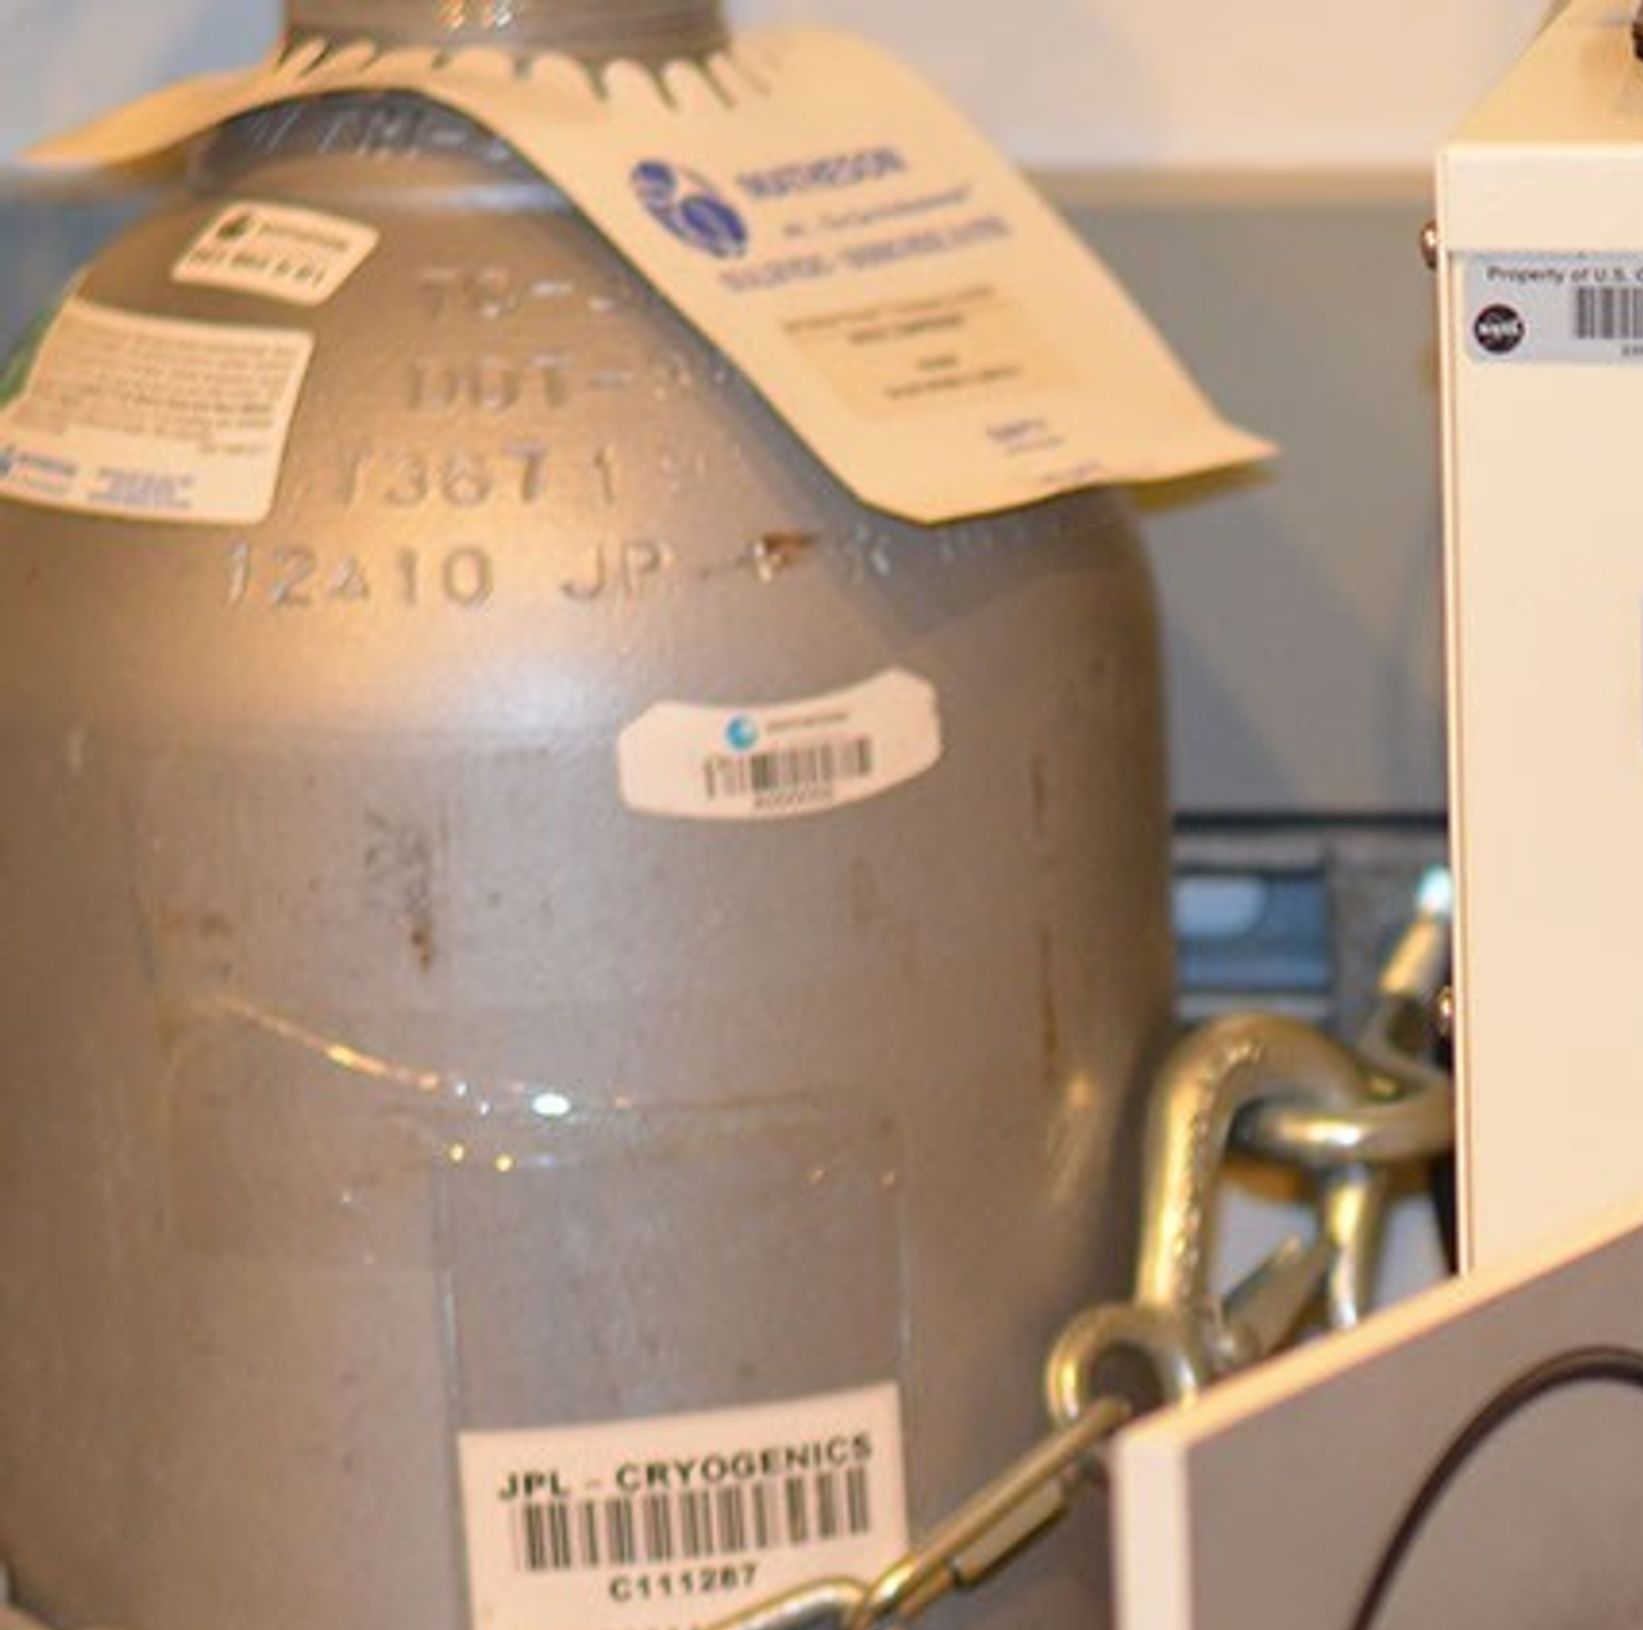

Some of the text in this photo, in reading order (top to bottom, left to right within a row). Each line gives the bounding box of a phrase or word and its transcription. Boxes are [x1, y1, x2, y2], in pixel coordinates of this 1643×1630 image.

[1487, 267, 1564, 284] Property
[1570, 268, 1589, 282] of
[499, 1470, 571, 1501] JPL
[615, 1432, 874, 1492] CRYOGENICS
